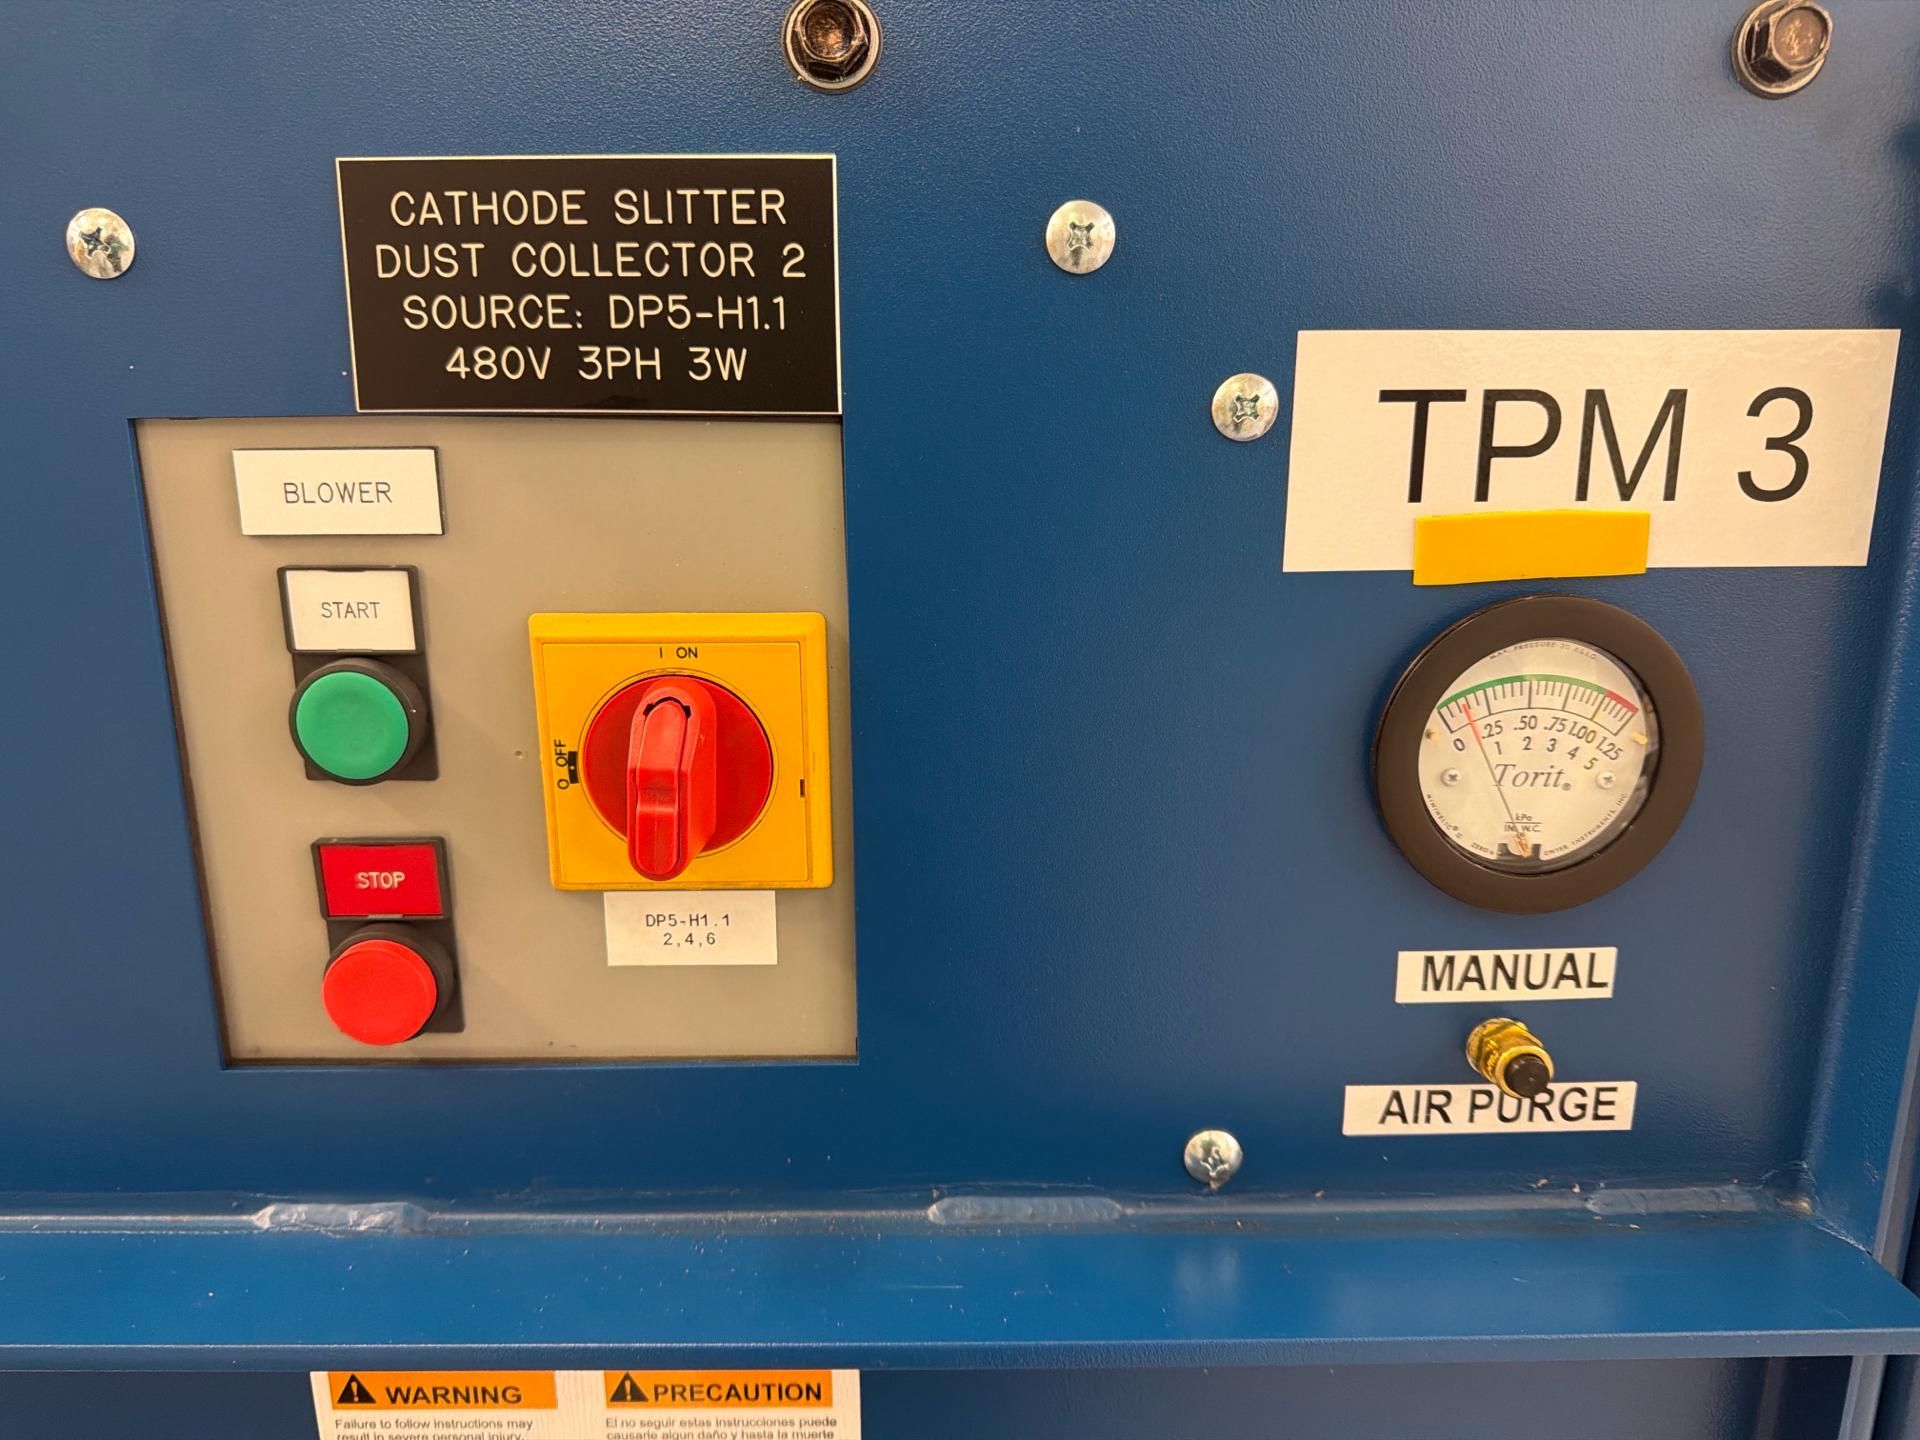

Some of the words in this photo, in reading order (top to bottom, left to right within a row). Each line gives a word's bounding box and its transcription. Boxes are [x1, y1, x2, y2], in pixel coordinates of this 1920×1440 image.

[390, 190, 588, 226] CATHODE
[614, 188, 787, 225] SLITTER
[376, 243, 485, 279] DUST
[511, 242, 755, 278] COLLECTOR
[782, 242, 807, 278] 2
[403, 295, 583, 330] SOURCE:
[609, 294, 786, 330] DP5-H1.1
[445, 346, 552, 380] 480V
[578, 346, 661, 380] 3PH
[688, 347, 748, 381] 3W
[1378, 388, 1688, 503] TPM
[1737, 386, 1814, 502] 3
[283, 482, 393, 504] BLOWER
[320, 601, 380, 619] START
[676, 647, 698, 659] ON
[1453, 738, 1466, 752] 0
[1481, 720, 1504, 739] .25
[1513, 715, 1538, 731] .50
[1543, 716, 1568, 733] .75
[1568, 721, 1598, 745] 1.00
[1598, 736, 1624, 761] 1.25
[553, 738, 568, 767] OFF
[1521, 736, 1533, 751] 2
[1546, 738, 1558, 753] 3
[1567, 746, 1580, 760] 4
[1584, 757, 1599, 770] 5
[355, 871, 406, 889] STOP
[645, 914, 731, 928] DP5-H1.1
[1421, 952, 1609, 992] MANUAL
[1378, 1088, 1453, 1125] AIR
[1467, 1086, 1618, 1124] PURGE
[386, 1386, 523, 1405] WARNING
[653, 1382, 823, 1402] PRECAUTION
[335, 1419, 377, 1430] Failure
[380, 1419, 392, 1430] to
[395, 1419, 431, 1430] follow
[434, 1418, 503, 1430] instructions
[506, 1419, 534, 1431] may
[605, 1417, 617, 1428] El
[621, 1419, 636, 1428] no
[639, 1416, 675, 1430] seguir
[679, 1417, 712, 1428] estas
[716, 1416, 795, 1428] instrucciones
[799, 1416, 838, 1430] puede
[337, 1431, 370, 1440] result
[373, 1431, 385, 1440] in
[388, 1432, 429, 1440] severe
[432, 1431, 485, 1440] personal
[699, 1430, 728, 1440] daño
[730, 1431, 737, 1440] y
[741, 1430, 774, 1440] hasta
[777, 1429, 788, 1440] la
[792, 1430, 835, 1440] muerte
